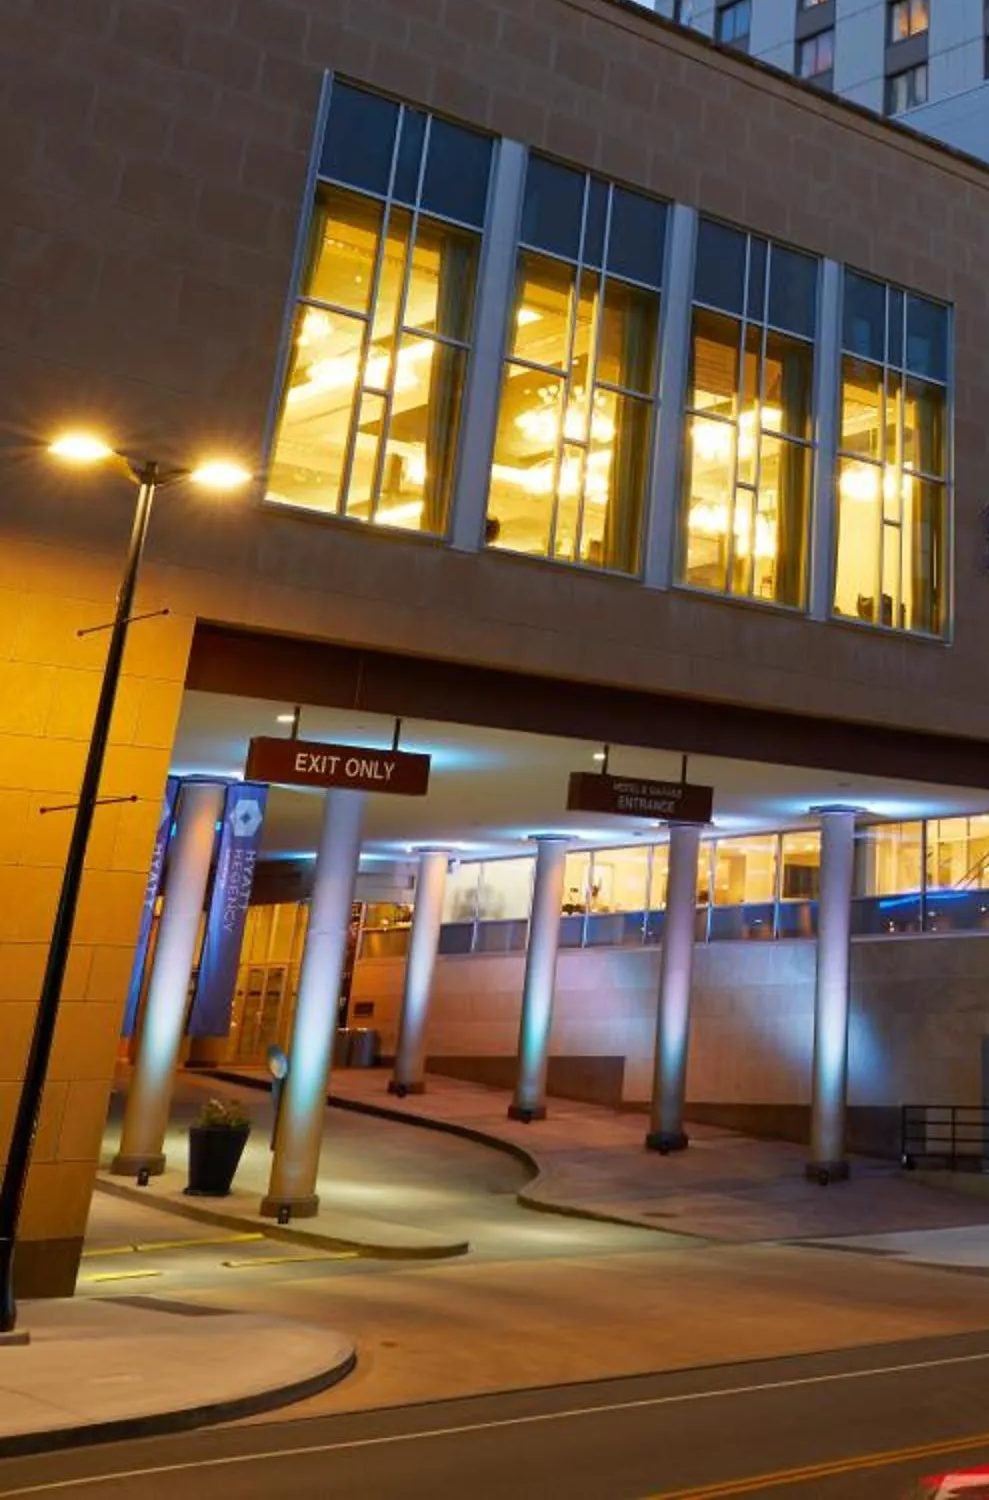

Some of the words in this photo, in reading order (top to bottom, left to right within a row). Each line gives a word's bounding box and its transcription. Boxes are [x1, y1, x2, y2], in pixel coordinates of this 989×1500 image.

[294, 752, 341, 775] EXIT
[344, 757, 396, 781] ONLY
[617, 794, 676, 814] ENTRANCE
[223, 848, 241, 933] REGENCY
[239, 850, 257, 910] HYATT
